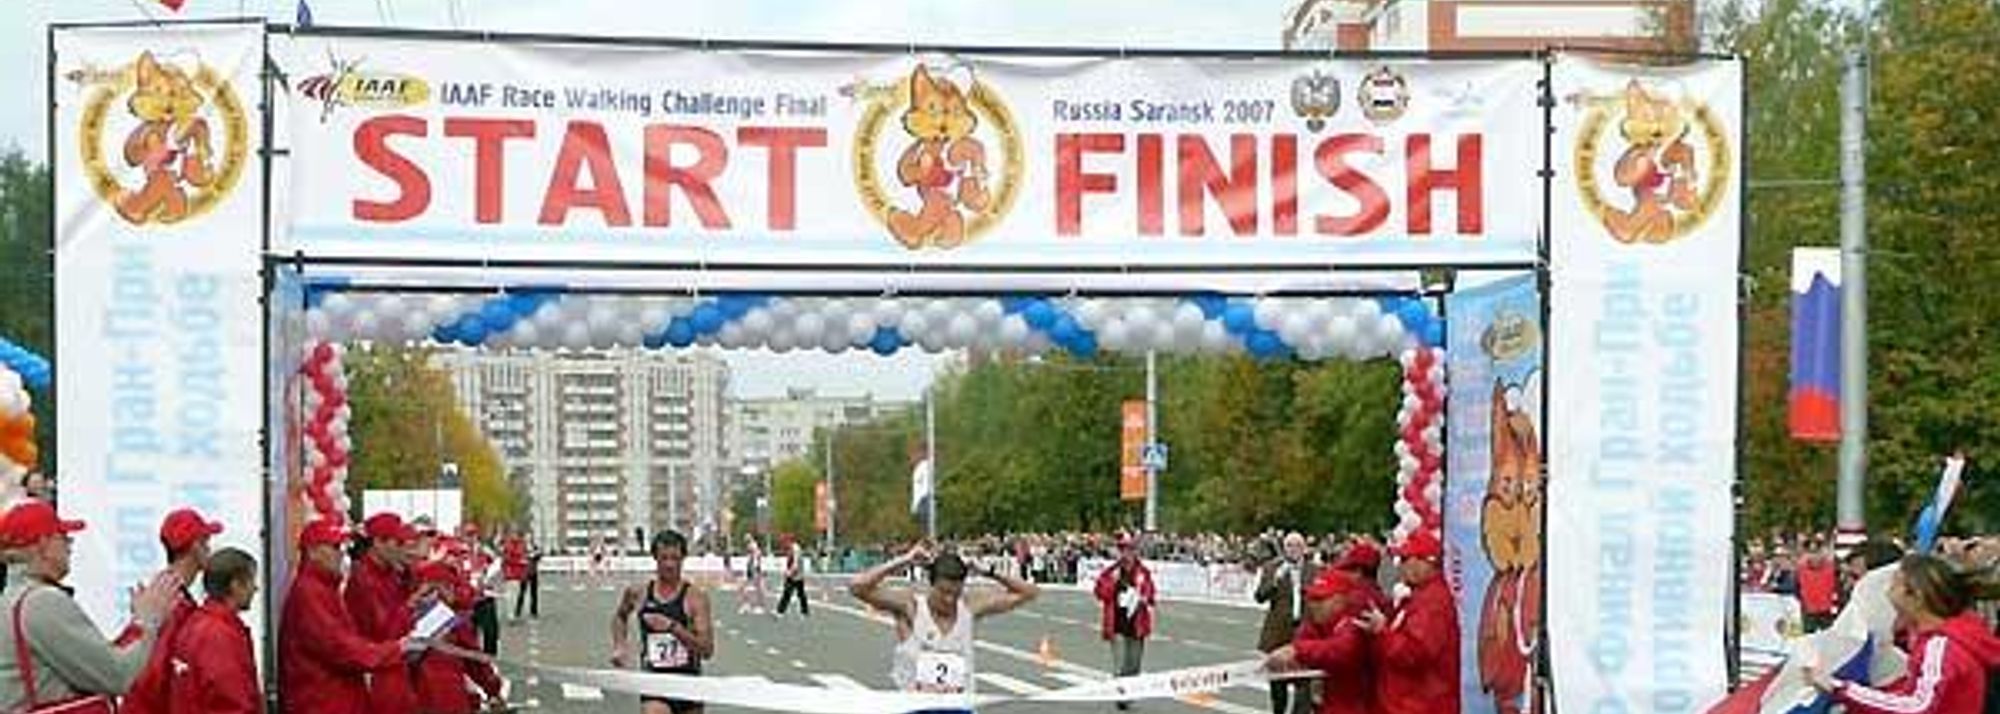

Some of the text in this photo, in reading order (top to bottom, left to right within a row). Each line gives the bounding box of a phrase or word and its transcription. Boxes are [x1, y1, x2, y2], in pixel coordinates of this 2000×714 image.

[441, 82, 828, 119] IAAF Race Walking Challenge Final
[1052, 99, 1276, 124] Russia Saransk 2007
[352, 114, 828, 231] START
[1054, 132, 1483, 238] FINISH
[935, 662, 949, 684] 2
